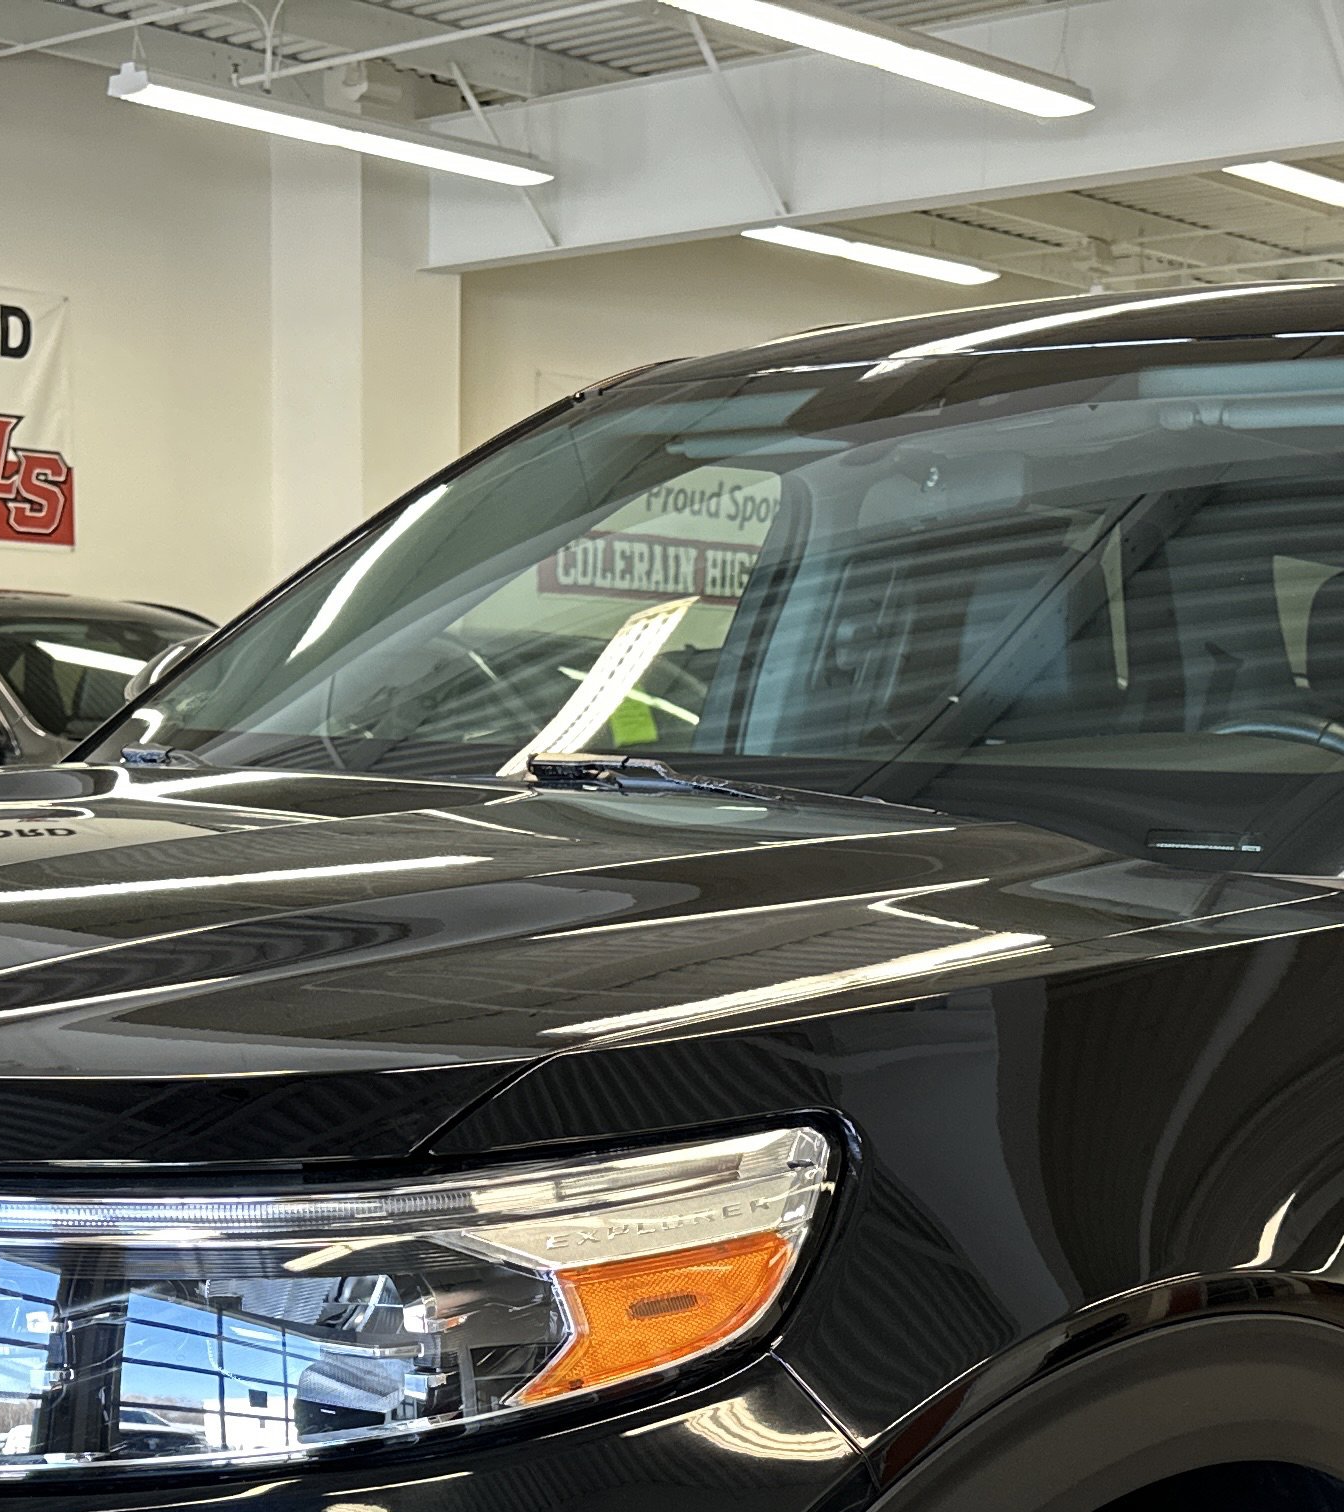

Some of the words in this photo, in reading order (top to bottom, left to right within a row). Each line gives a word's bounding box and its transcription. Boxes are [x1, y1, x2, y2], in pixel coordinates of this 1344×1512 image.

[645, 480, 724, 518] Proud
[558, 539, 699, 594] COLERAIN
[706, 550, 757, 597] HIG
